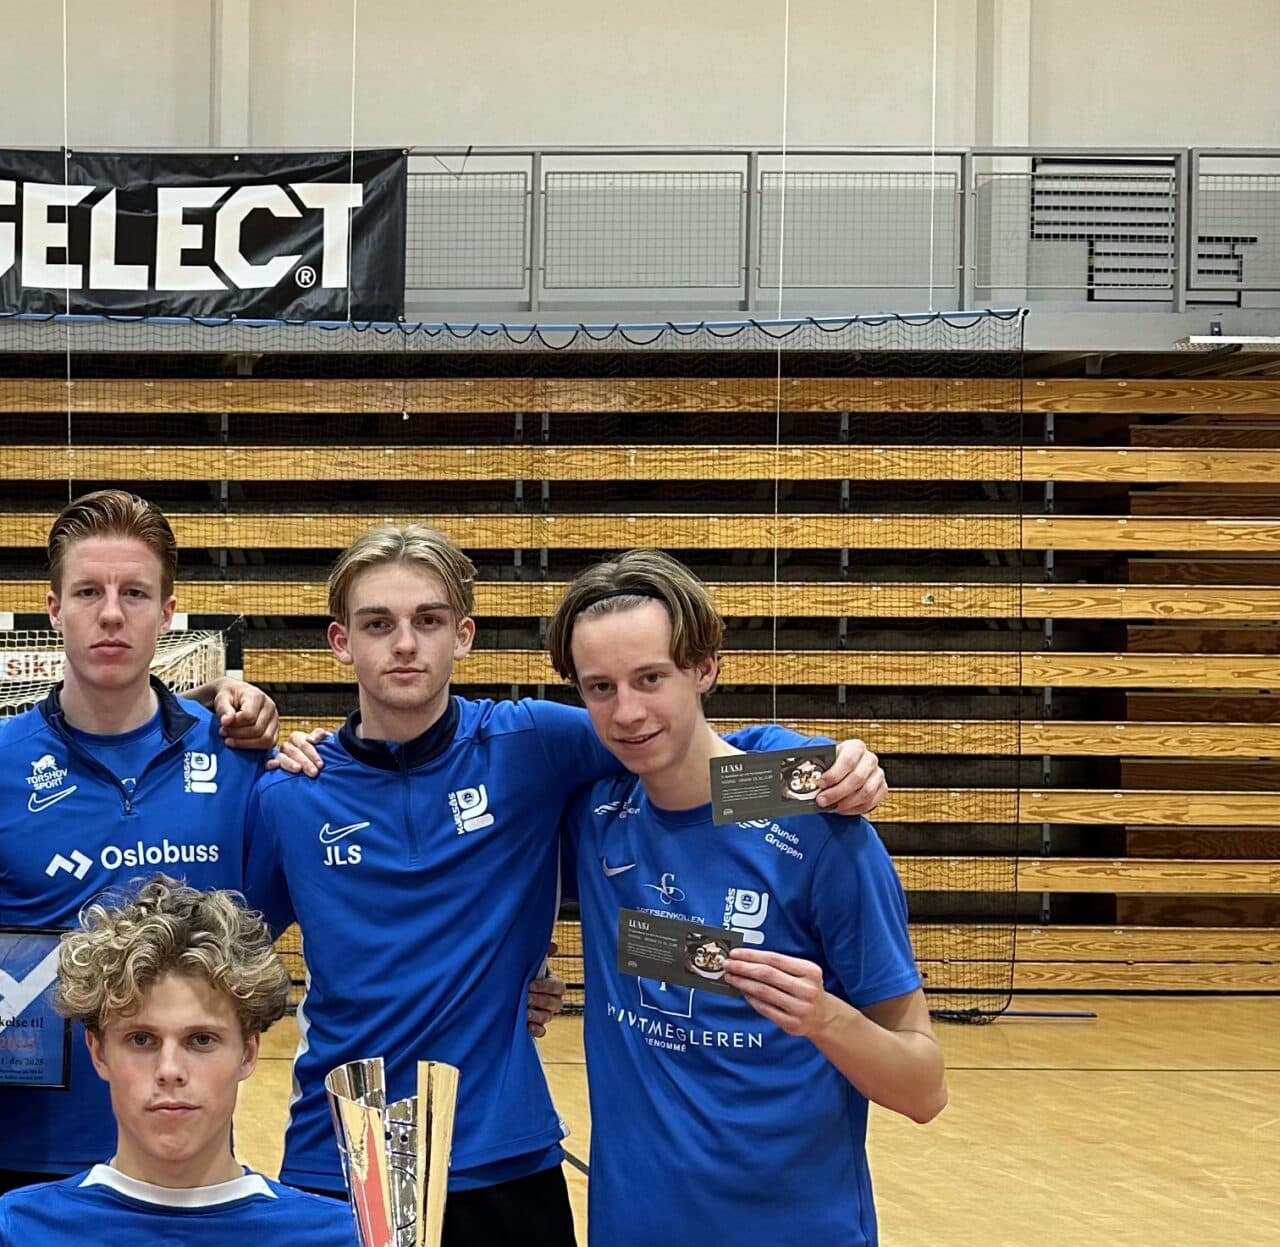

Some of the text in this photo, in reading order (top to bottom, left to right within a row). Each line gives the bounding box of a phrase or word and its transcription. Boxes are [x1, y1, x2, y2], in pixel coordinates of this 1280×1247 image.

[24, 768, 68, 785] TORSHOV
[33, 776, 63, 791] SPORT
[770, 823, 800, 845] Bunde
[100, 839, 220, 871] Oslobuss
[323, 844, 362, 867] JLS
[764, 833, 804, 861] Gruppen
[30, 1015, 44, 1029] til
